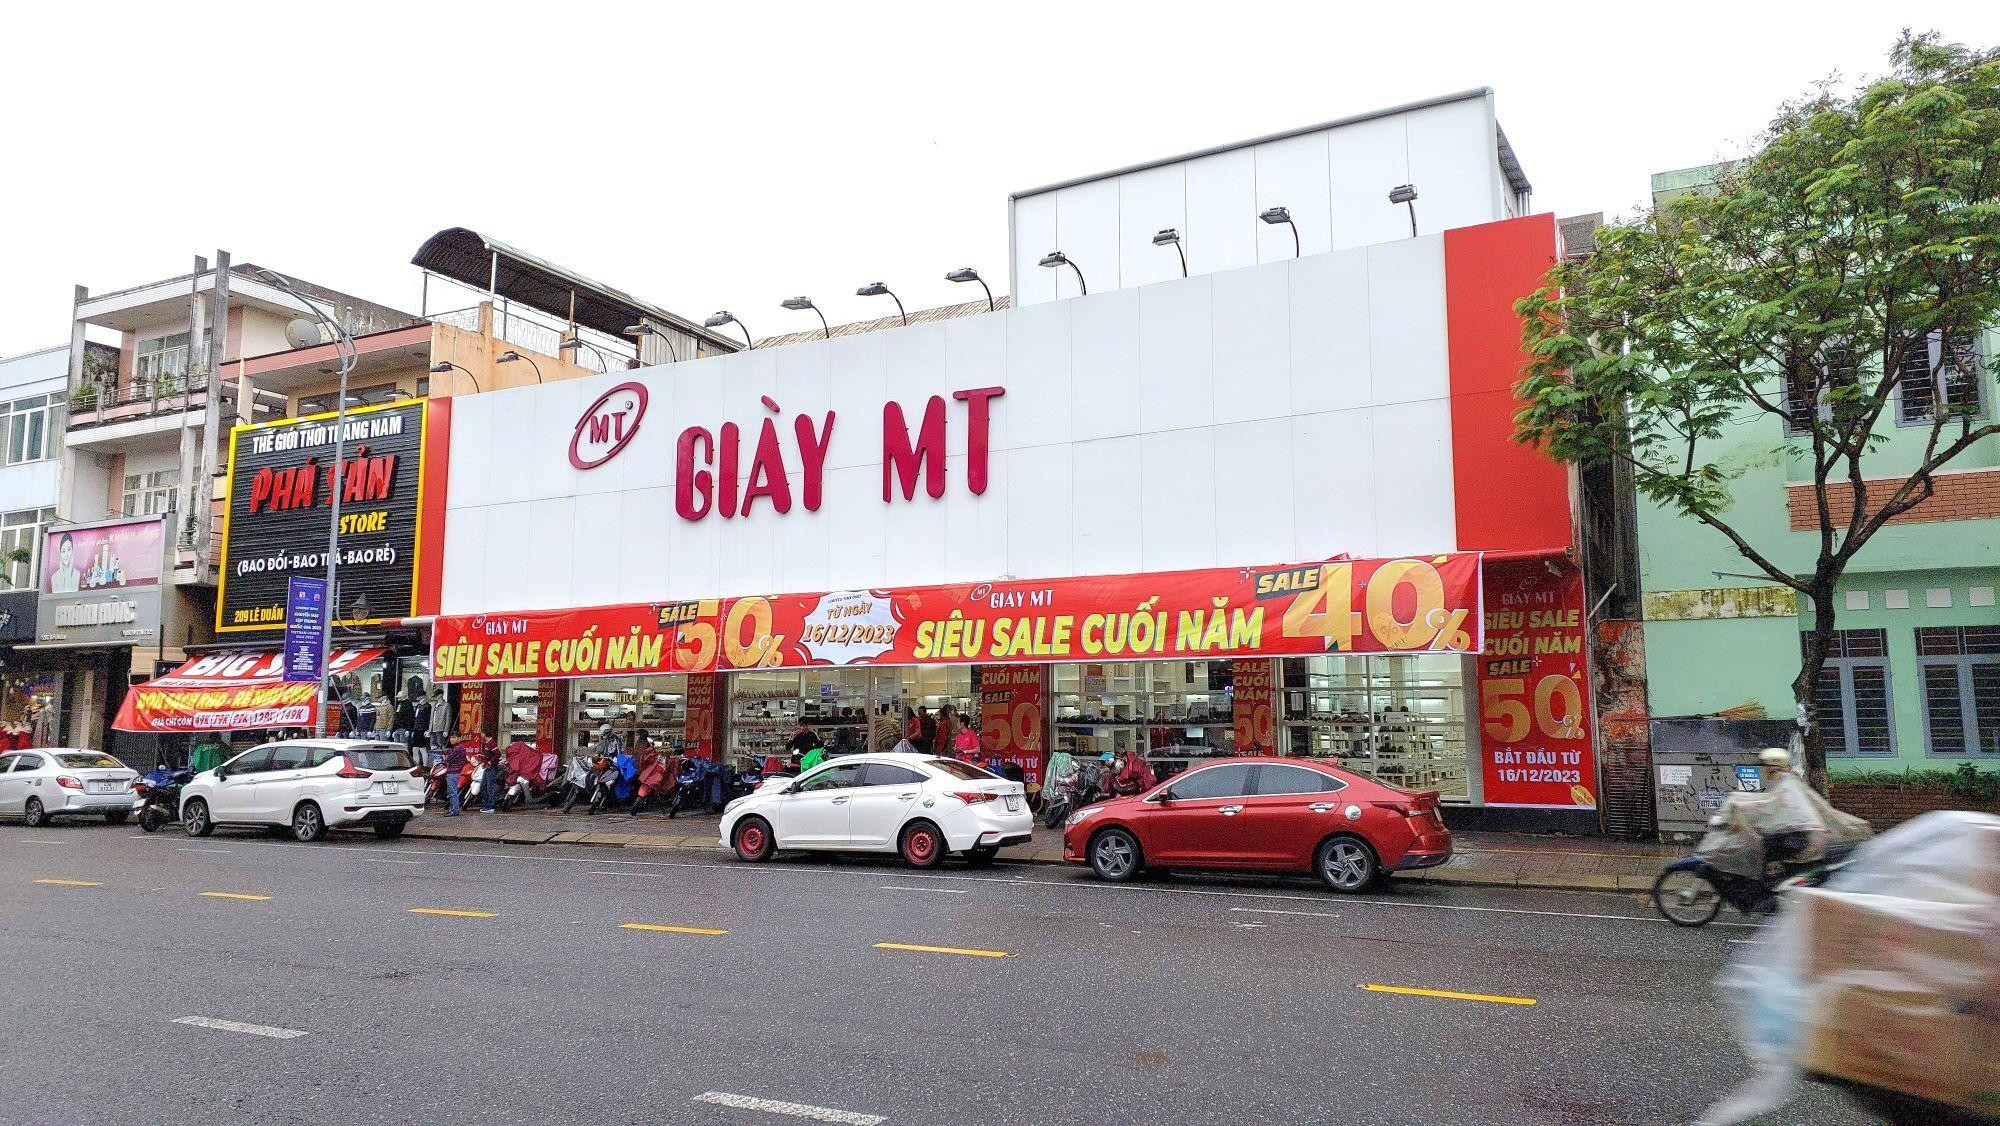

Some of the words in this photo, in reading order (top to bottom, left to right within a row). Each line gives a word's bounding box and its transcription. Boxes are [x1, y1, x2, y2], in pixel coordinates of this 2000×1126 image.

[253, 428, 275, 454] THẾ
[275, 427, 298, 449] GIỚI
[300, 424, 325, 446] THỜI
[370, 416, 402, 437] NAM
[589, 411, 625, 444] MT
[675, 395, 836, 521] GIÀY
[883, 386, 1006, 502] MT
[339, 511, 388, 534] STORE
[237, 559, 265, 577] (BAO
[375, 543, 396, 564] RẺ)
[1256, 568, 1319, 594] SALE
[990, 588, 1026, 608] GIÀY
[1030, 589, 1055, 606] MT
[1282, 559, 1471, 651] 40%
[234, 610, 249, 623] 209
[250, 606, 260, 622] LÊ
[261, 604, 284, 621] DUẨN
[659, 603, 699, 624] SALE
[1483, 607, 1524, 630] SIÊU
[1528, 609, 1580, 629] SALE
[486, 617, 509, 636] GIÀY
[512, 619, 528, 634] MT
[675, 596, 785, 671] 50%
[803, 622, 894, 648] 16/12/2023
[912, 609, 985, 658] SIÊU
[989, 614, 1073, 657] SALE
[1076, 595, 1168, 654] CUỐI
[1175, 596, 1265, 652] NĂM
[435, 637, 483, 678] SIÊU
[487, 640, 542, 676] SALE
[545, 624, 602, 673] CUỐI
[604, 627, 664, 670] NĂM
[1483, 631, 1529, 656] CUỐI
[1534, 630, 1582, 655] NĂM
[182, 654, 260, 677] BIG
[981, 668, 1010, 685] CUỐI
[1012, 669, 1039, 684] NĂM
[1232, 662, 1269, 673] SALE
[1487, 659, 1531, 676] SALE
[1233, 672, 1270, 687] CUỐI
[984, 691, 1011, 703] SALE
[1234, 687, 1269, 701] NĂM
[1026, 755, 1039, 768] TỪ
[1494, 748, 1521, 764] BẮT
[1526, 747, 1556, 765] ĐẦU
[1561, 748, 1581, 765] TỪ
[1497, 769, 1581, 783] 16/12/2023
